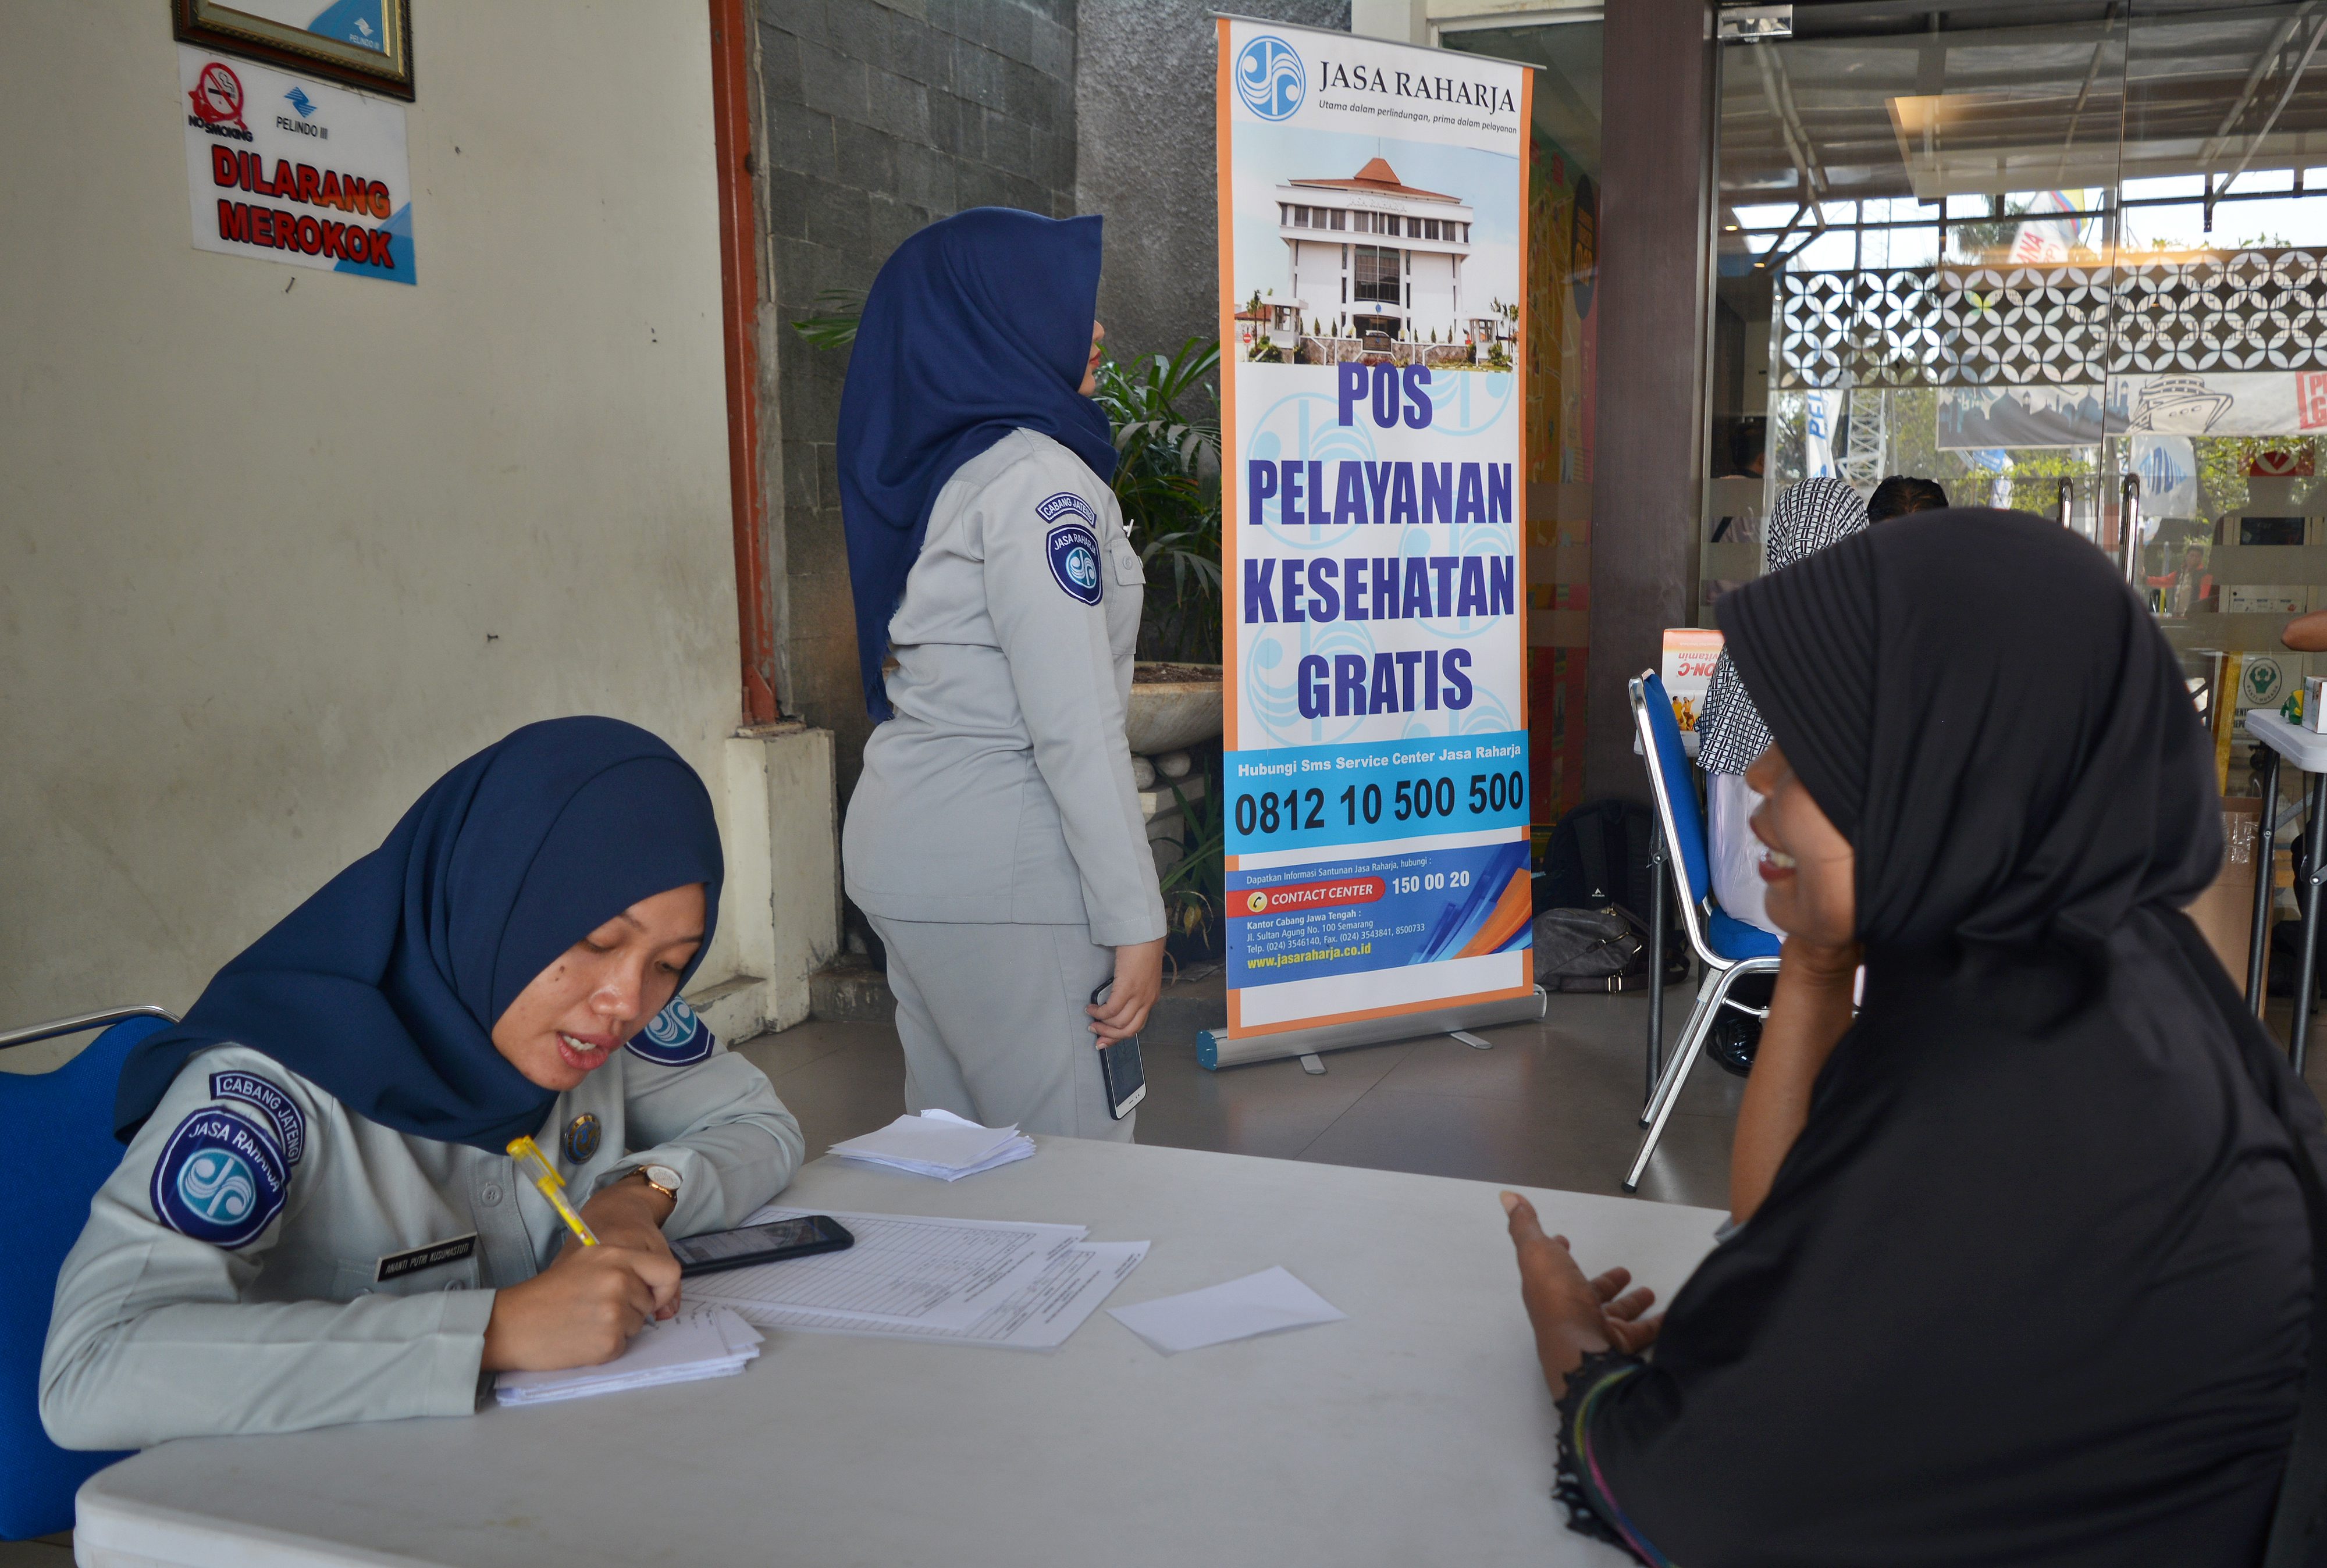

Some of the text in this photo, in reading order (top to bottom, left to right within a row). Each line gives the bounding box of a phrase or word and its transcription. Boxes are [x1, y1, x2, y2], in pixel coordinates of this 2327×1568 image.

[1319, 60, 1515, 115] JASA RAHARJA
[188, 115, 253, 142] NO SMOKING
[276, 116, 328, 140] PELINDO III
[1319, 99, 1517, 134] Utama dalam perlindungan, prima dalam pelayanan
[211, 144, 391, 220] DILARANG
[217, 198, 395, 269] MEROKOK
[1337, 361, 1433, 430] POS
[1248, 459, 1513, 525] PELAYANAN
[1044, 498, 1072, 516] CABANG
[1054, 533, 1096, 556] JASA RAHARJA
[1244, 555, 1514, 623] KESEHATAN
[1677, 662, 1716, 676] ON-C
[1678, 653, 1718, 661] vitamin
[1297, 647, 1473, 719] GRATIS
[1238, 744, 1521, 777] Hubungi Sms Service Center Jasa Raharja
[1234, 770, 1524, 836] 0812 10 500 500
[1247, 873, 1282, 886] Dapatkan
[1283, 869, 1317, 881] Informasi
[1318, 865, 1353, 877] Santunan
[1354, 864, 1370, 874] Jasa
[1372, 861, 1399, 872] Raharja,
[1400, 857, 1428, 868] hubungi
[1392, 871, 1470, 895] 150 00 20
[1271, 884, 1374, 905] CONTACT CENTER
[1247, 920, 1273, 930] Kantor
[1276, 916, 1304, 929] Cabang
[1307, 914, 1326, 923] Jawa
[1328, 910, 1356, 922] Tengah
[1257, 930, 1280, 940] Sultan
[1282, 928, 1305, 940] Agung
[1307, 925, 1319, 935] No.
[1322, 923, 1336, 932] 100
[1337, 920, 1374, 931] Semarang
[1247, 923, 1425, 954] Telp. (024) 3546140, Fax. (024) 3543841, 8500733
[1247, 942, 1371, 969] www.jasaraharja.co.id
[189, 1121, 230, 1141] JASA
[222, 1078, 300, 1159] CABANG JATENG
[410, 1254, 428, 1267] PUTRI
